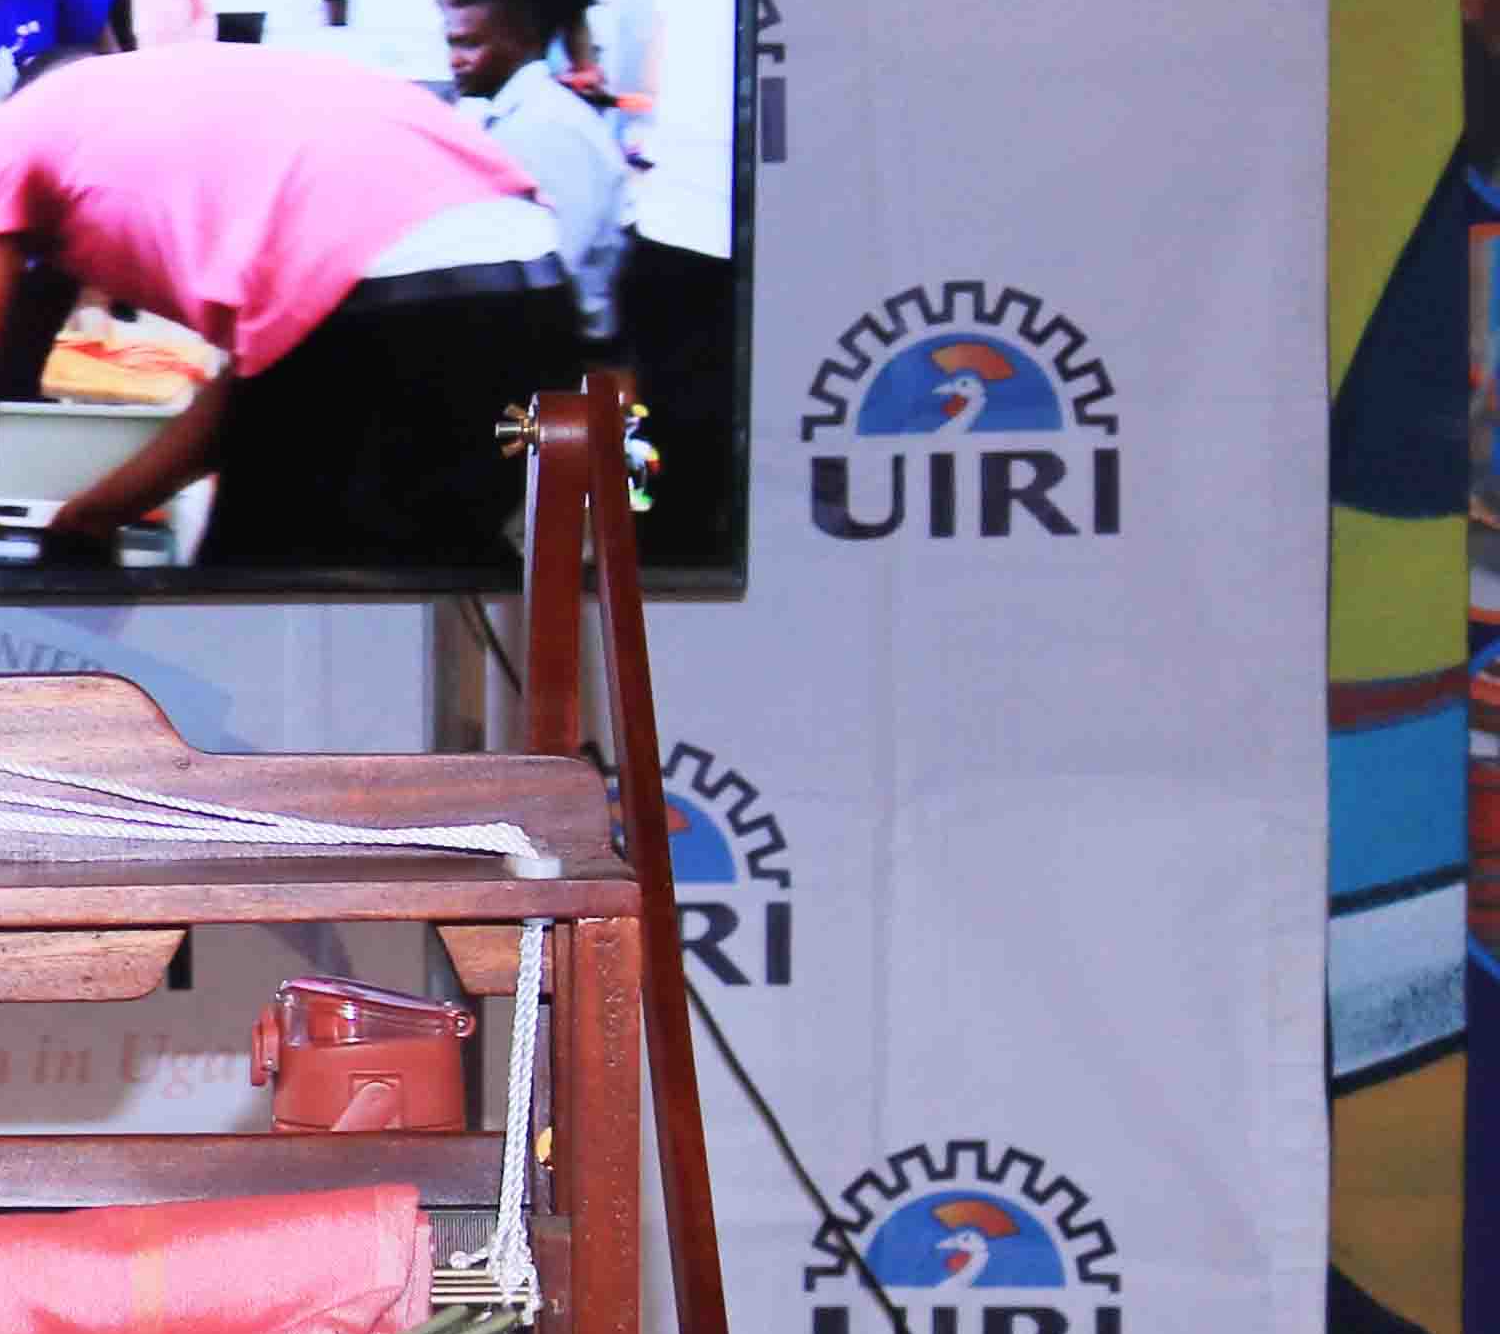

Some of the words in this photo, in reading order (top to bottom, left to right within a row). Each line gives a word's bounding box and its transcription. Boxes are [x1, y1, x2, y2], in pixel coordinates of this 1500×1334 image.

[811, 448, 1120, 541] UIRI
[678, 901, 792, 986] RI
[32, 1035, 95, 1085] in
